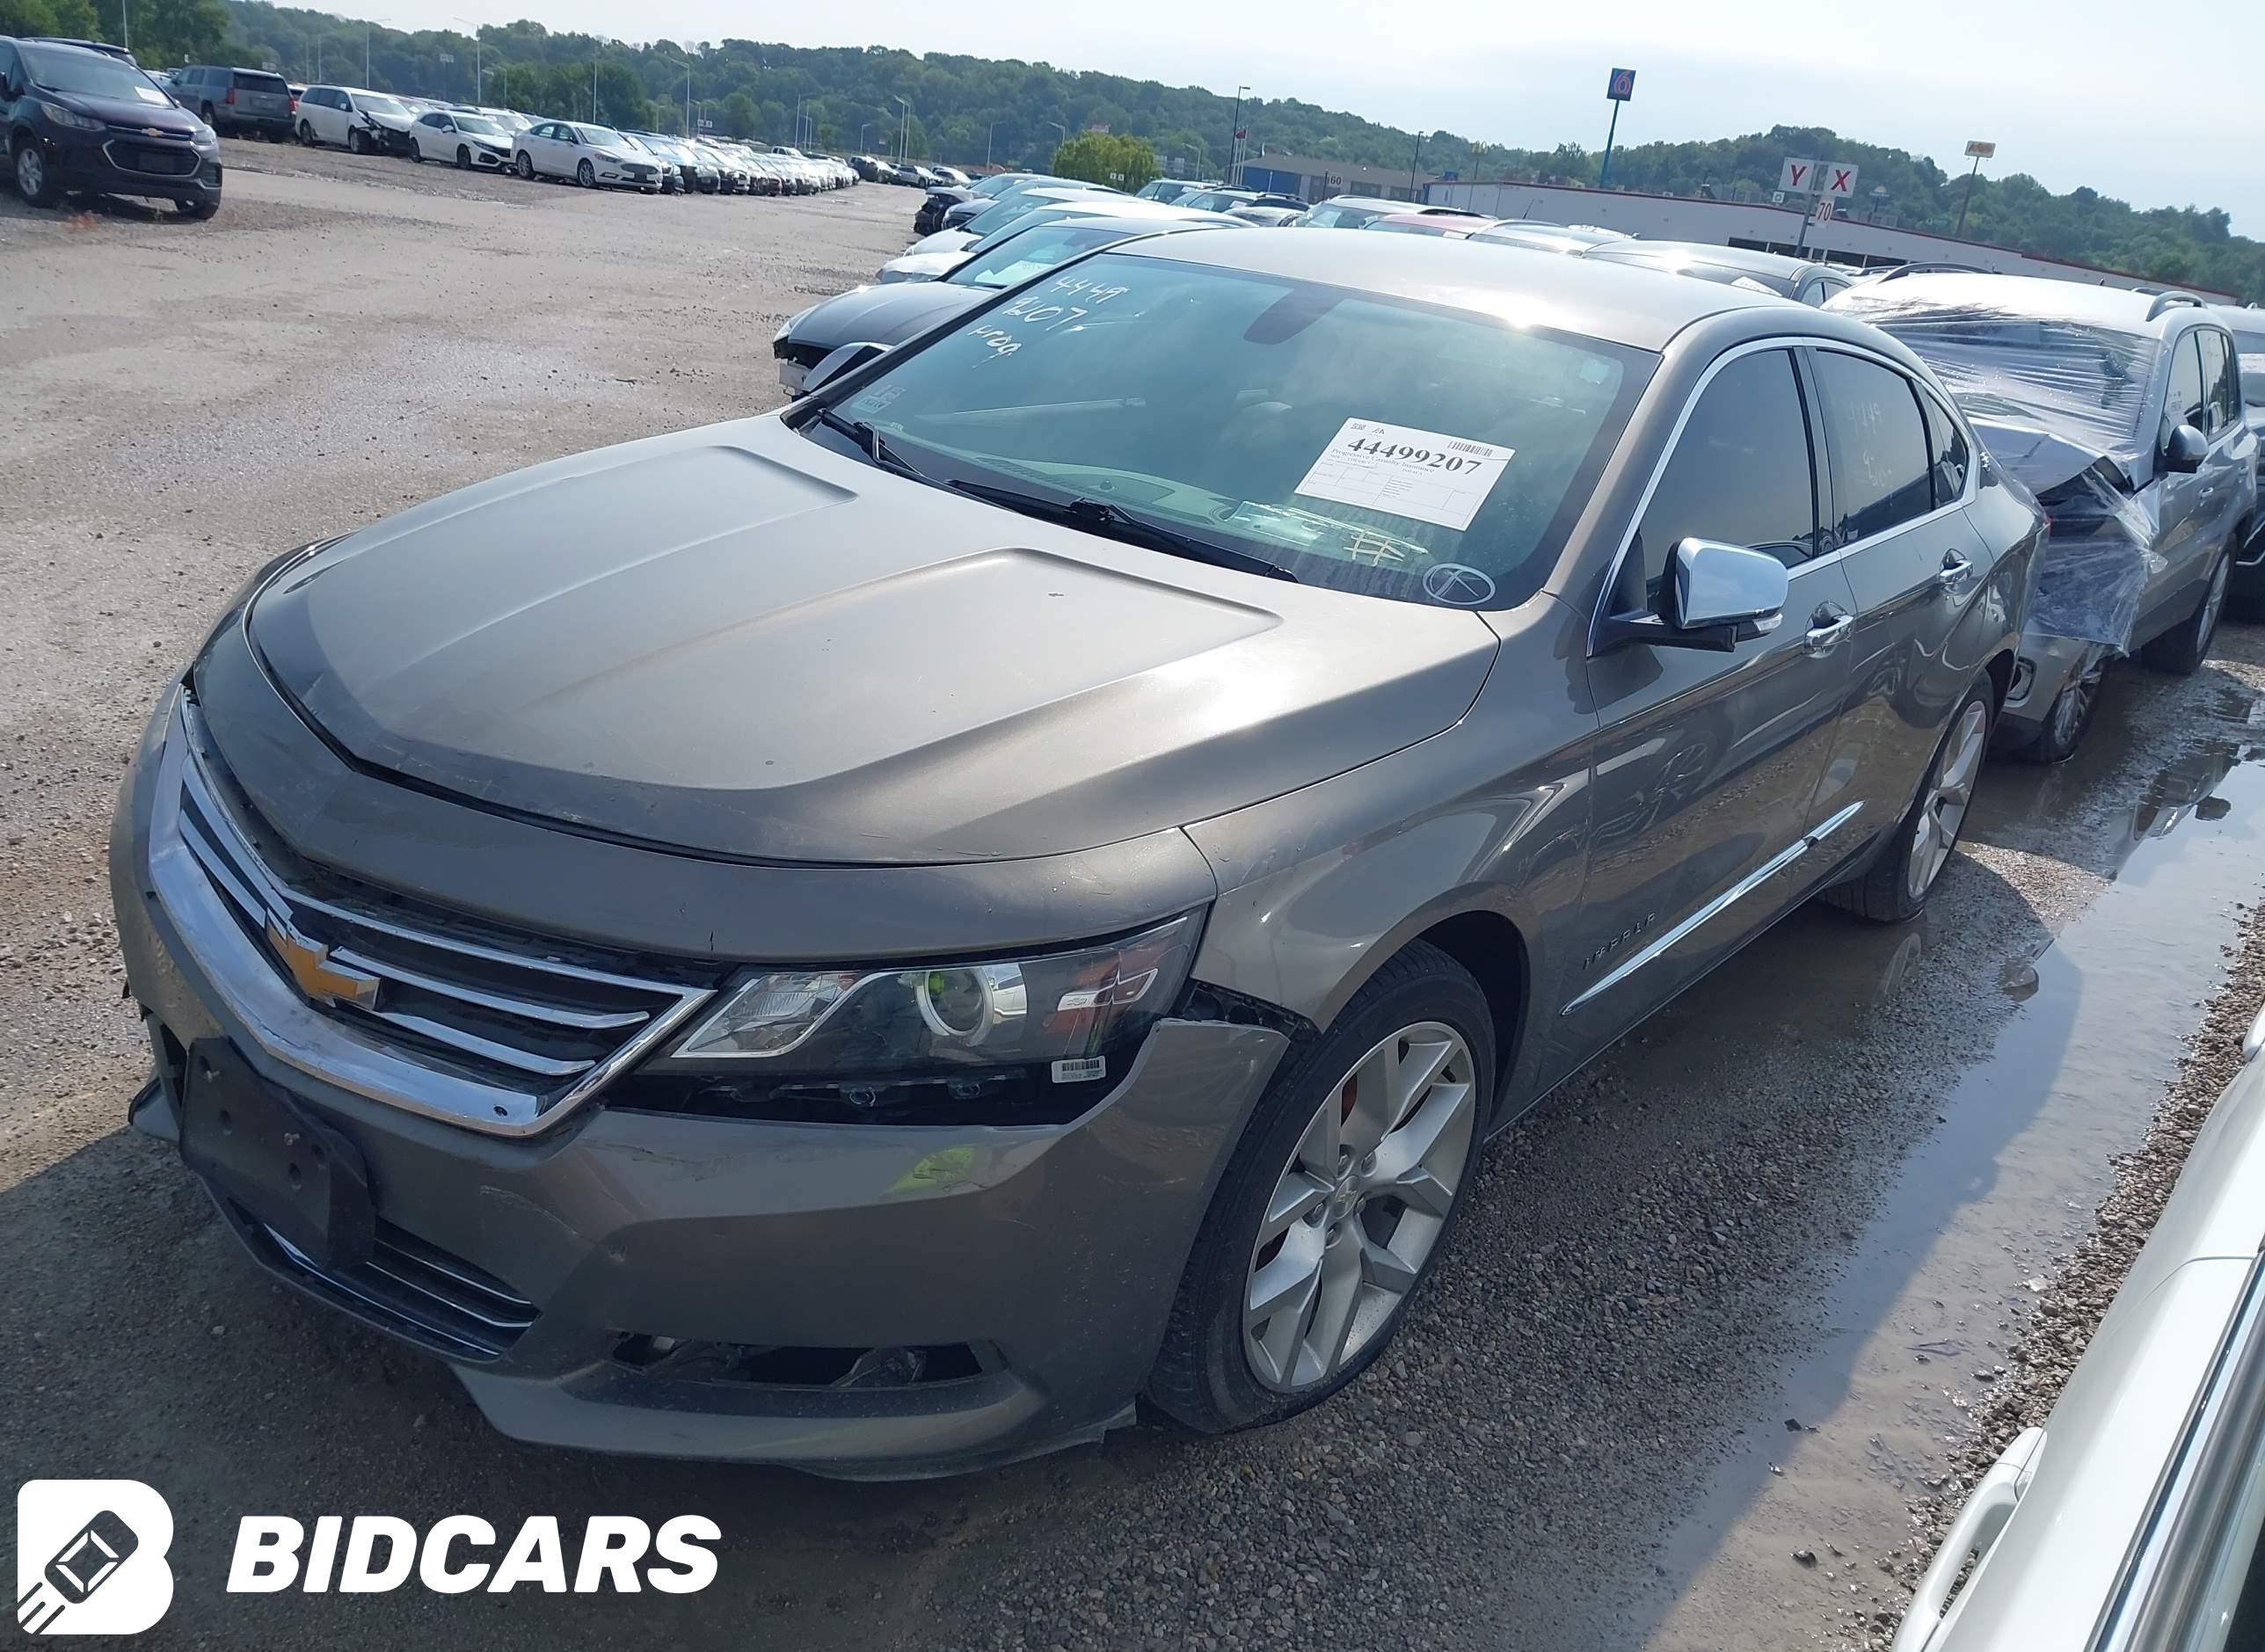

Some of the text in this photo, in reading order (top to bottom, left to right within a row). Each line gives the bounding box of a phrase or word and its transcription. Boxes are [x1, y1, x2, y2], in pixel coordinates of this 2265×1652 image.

[1613, 70, 1631, 94] 6
[1790, 164, 1852, 192] Y X
[1817, 202, 1832, 222] 70
[1050, 275, 1131, 305] 4449
[1346, 437, 1483, 476] 44499207
